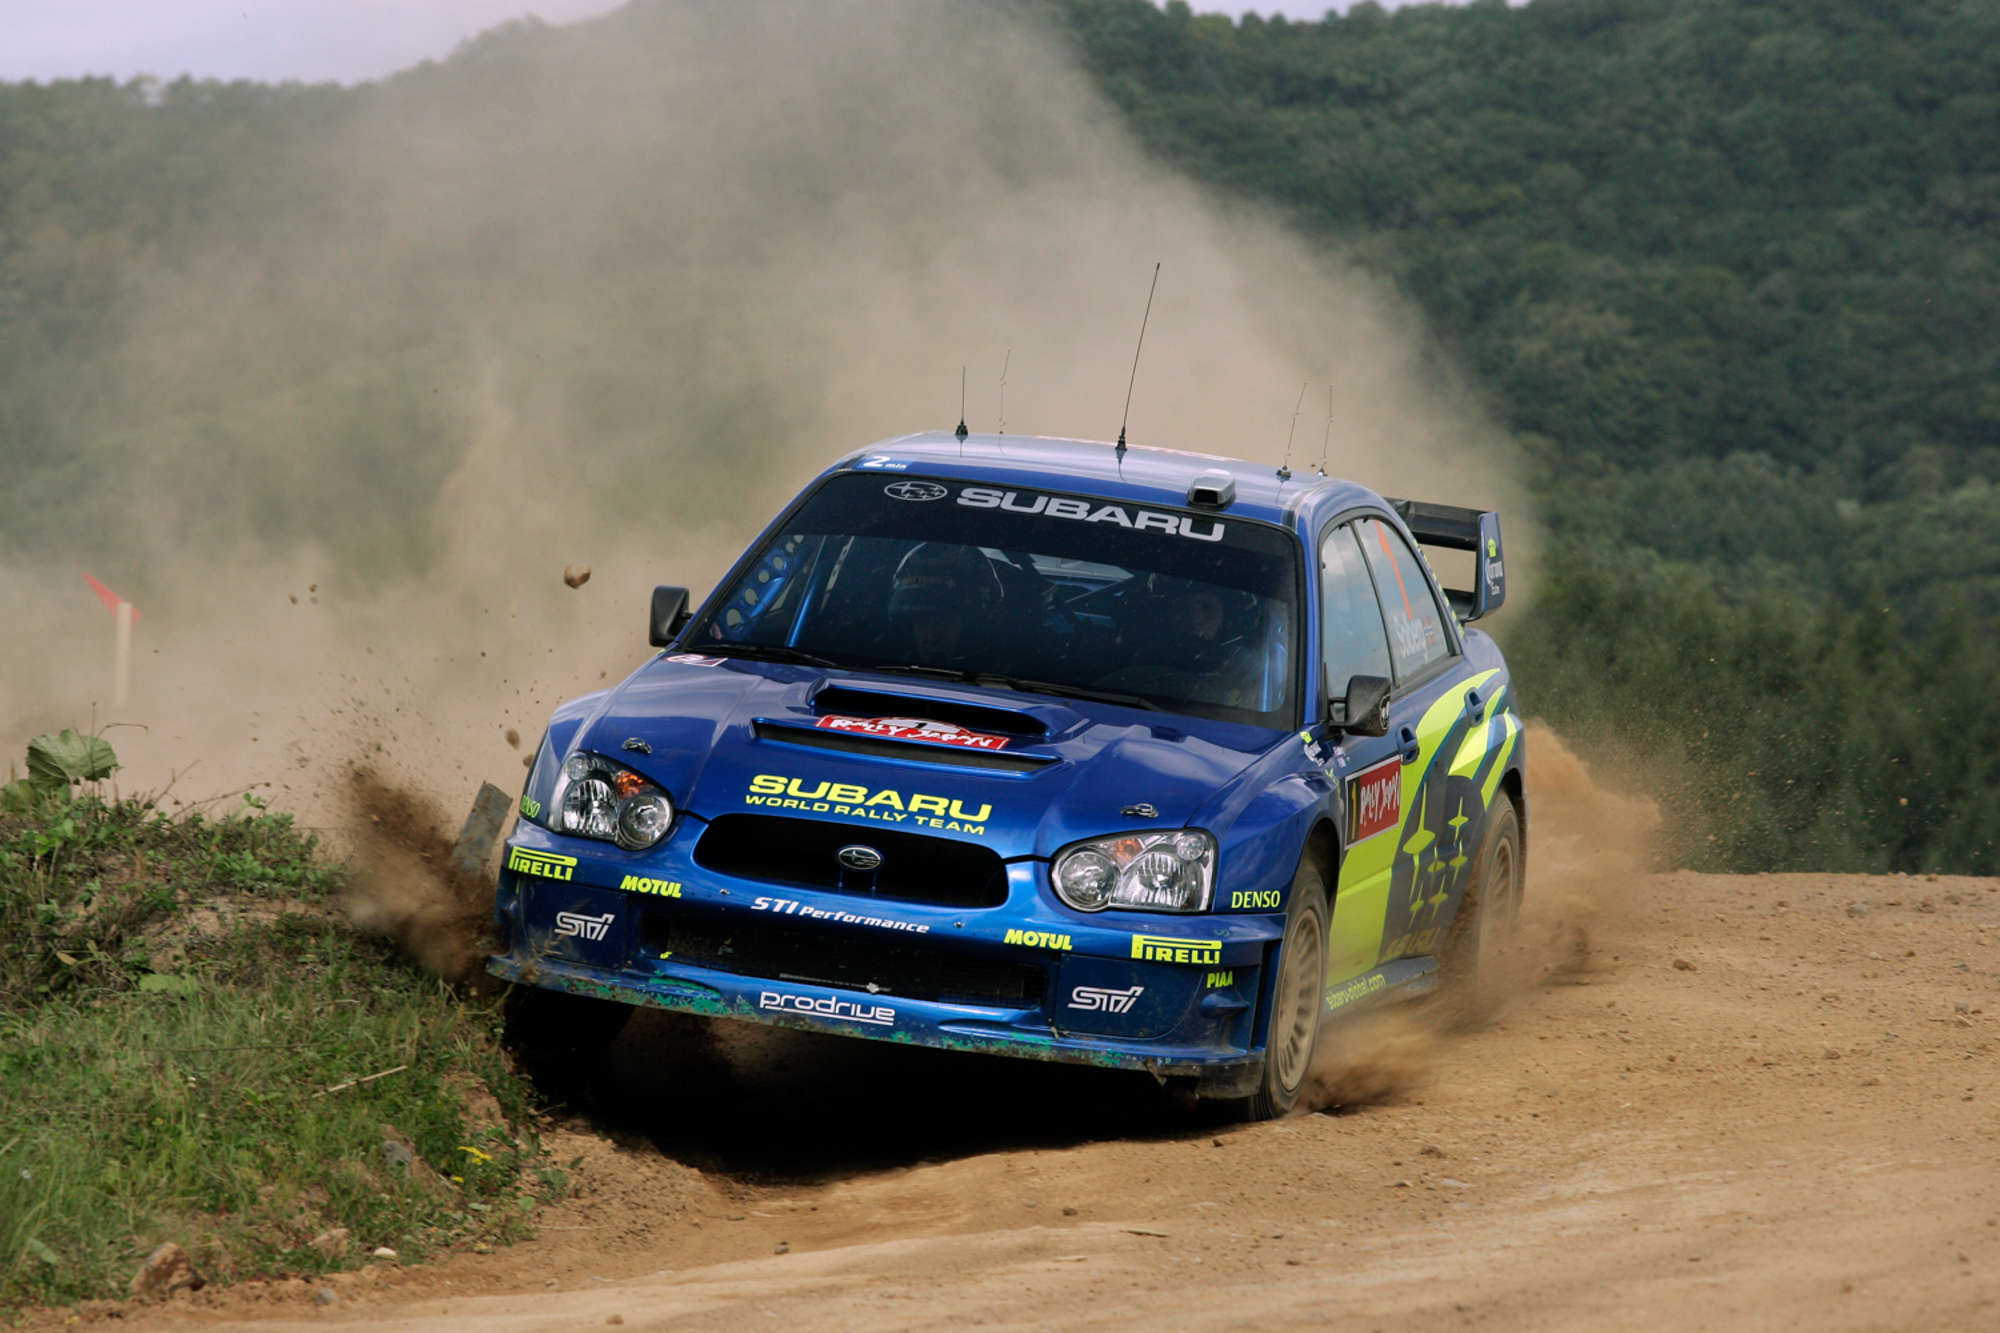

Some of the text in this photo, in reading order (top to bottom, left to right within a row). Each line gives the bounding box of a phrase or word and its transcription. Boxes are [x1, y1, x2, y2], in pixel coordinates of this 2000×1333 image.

[863, 456, 890, 467] 2
[956, 487, 1225, 542] SUBARU
[749, 774, 993, 822] SUBARU
[746, 795, 985, 836] WORLD RALLY TEAM
[508, 845, 578, 881] PIRELLI
[620, 875, 682, 898] MOTUL
[1231, 890, 1281, 909] DENSO
[751, 897, 930, 934] STI Performance
[1003, 929, 1073, 951] MOTUL
[1131, 934, 1222, 965] PIRELLI
[1206, 971, 1233, 989] PIAA
[759, 991, 896, 1023] prodrive
